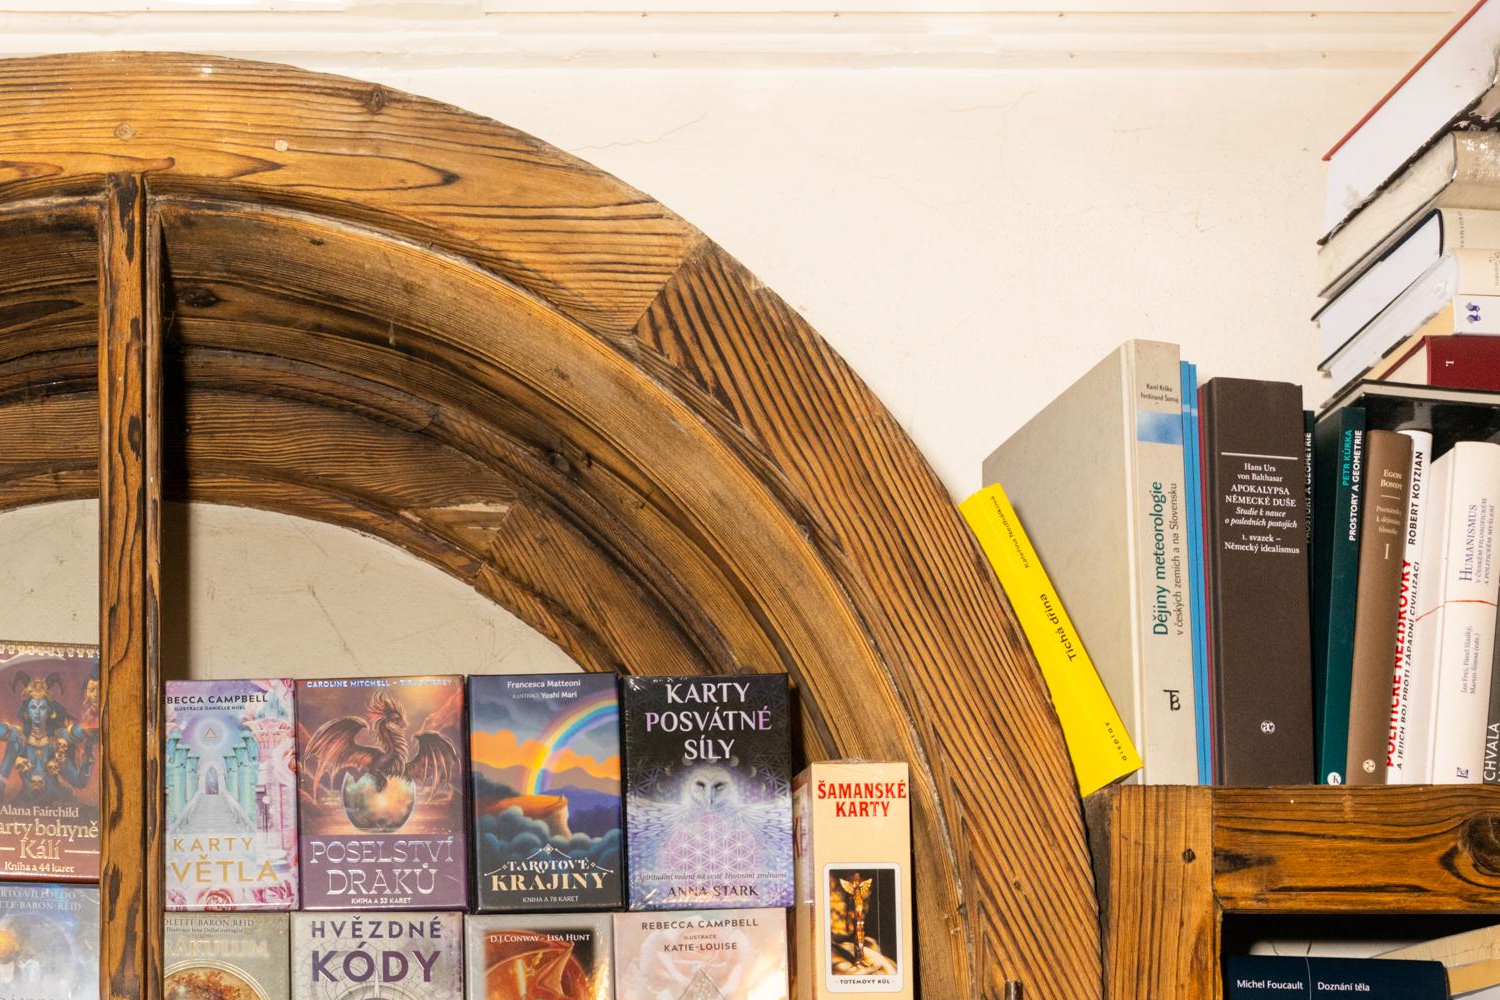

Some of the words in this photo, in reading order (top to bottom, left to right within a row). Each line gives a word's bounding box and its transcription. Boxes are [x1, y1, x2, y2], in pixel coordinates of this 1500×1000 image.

[1410, 451, 1424, 501] KOTZIAN
[1225, 495, 1271, 506] NĚMECKÉ
[1273, 497, 1297, 507] DUŠE
[1230, 484, 1290, 496] APOKALYPSA
[1152, 480, 1174, 581] meteorologie
[1407, 504, 1421, 546] ROBERT
[1152, 586, 1176, 636] Dějiny
[506, 680, 545, 689] Francesca
[546, 679, 581, 689] Matteoni
[666, 681, 751, 705] KARTY
[644, 706, 773, 733] POSVÁTNÉ
[683, 735, 736, 761] SÍLY
[817, 780, 908, 800] ŠAMANSKÉ
[835, 800, 891, 818] KARTY
[35, 817, 99, 840] bohyně
[18, 838, 61, 861] Kálí
[172, 836, 253, 852] KARTY
[309, 837, 454, 864] POSELSTVÍ
[326, 863, 438, 896] DRAKŮ
[490, 871, 610, 892] KRAJINY
[311, 916, 442, 939] HVĚZDNÉ
[311, 941, 442, 983] KÓDY
[1236, 979, 1265, 989] Michel
[1267, 980, 1304, 990] Foucault
[1317, 981, 1353, 992] Doznání
[1354, 981, 1370, 992] těla
